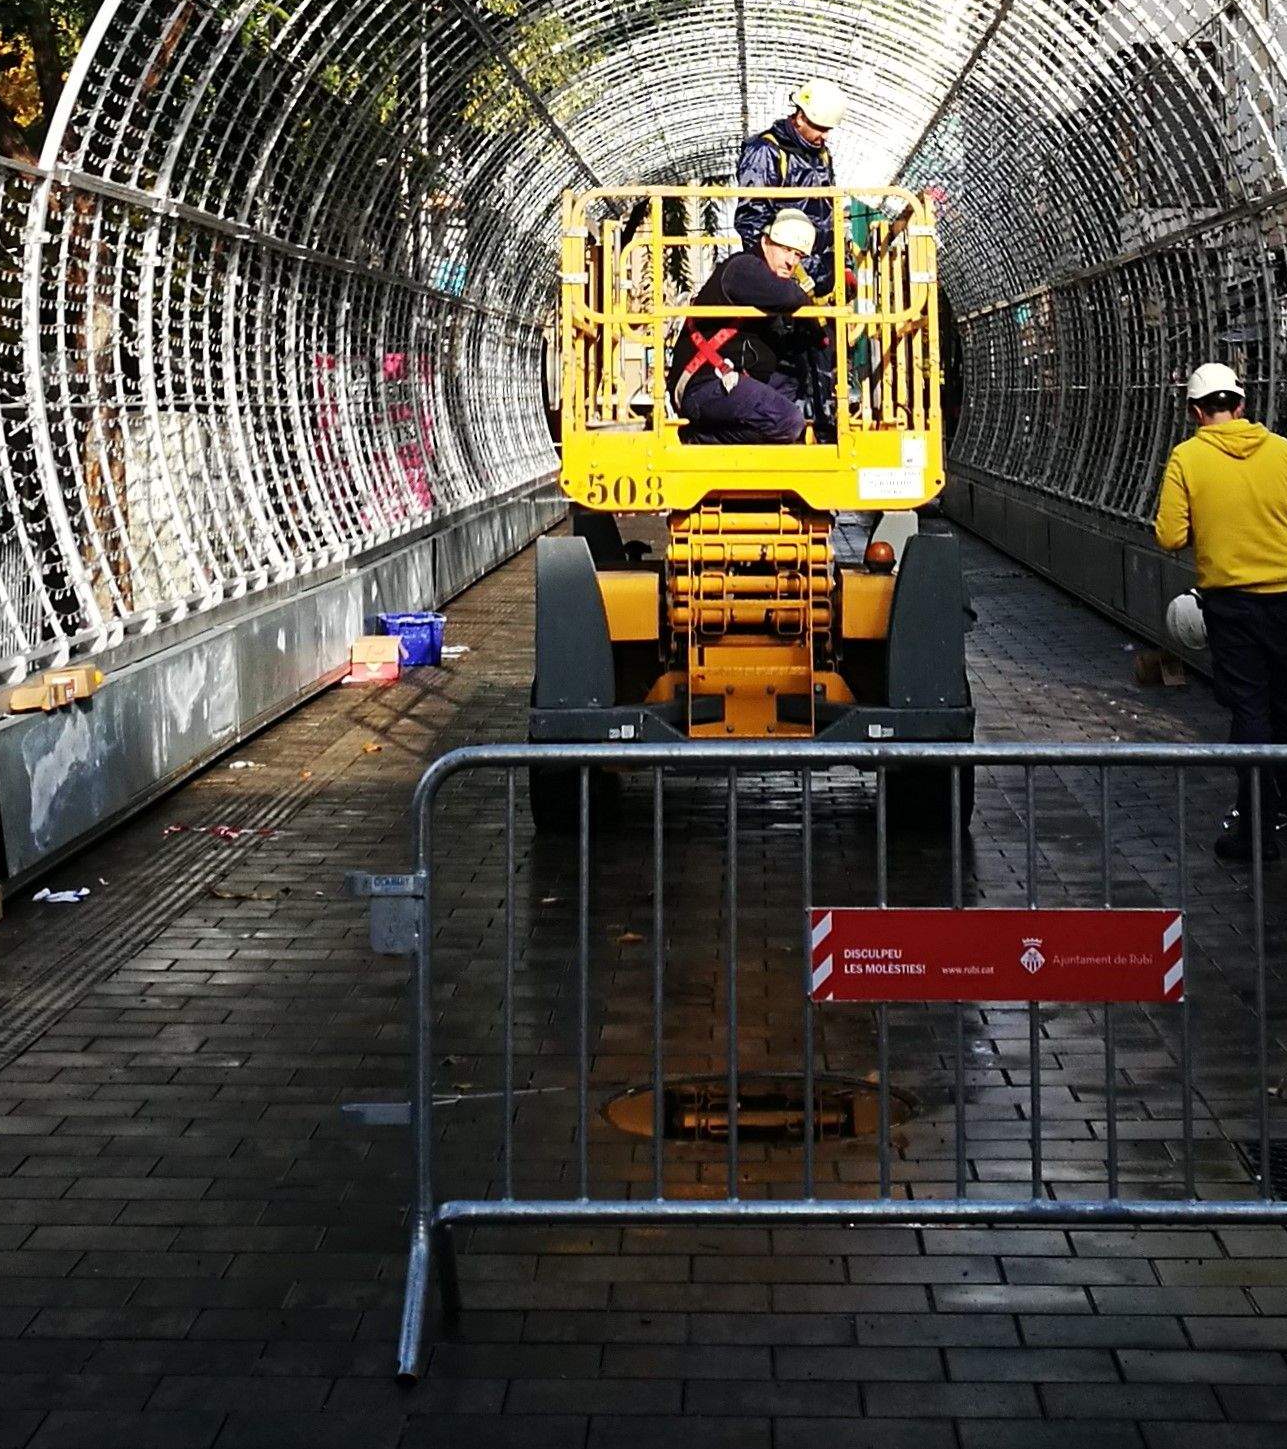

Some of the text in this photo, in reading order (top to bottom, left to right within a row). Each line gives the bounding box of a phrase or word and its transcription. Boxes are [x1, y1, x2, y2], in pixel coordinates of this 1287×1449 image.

[587, 473, 664, 507] 508
[844, 949, 902, 959] DISCULPEU
[1053, 954, 1111, 966] Ajuntament
[1113, 954, 1127, 965] de
[844, 964, 863, 974] LES
[941, 965, 994, 975] www.rubi.cat
